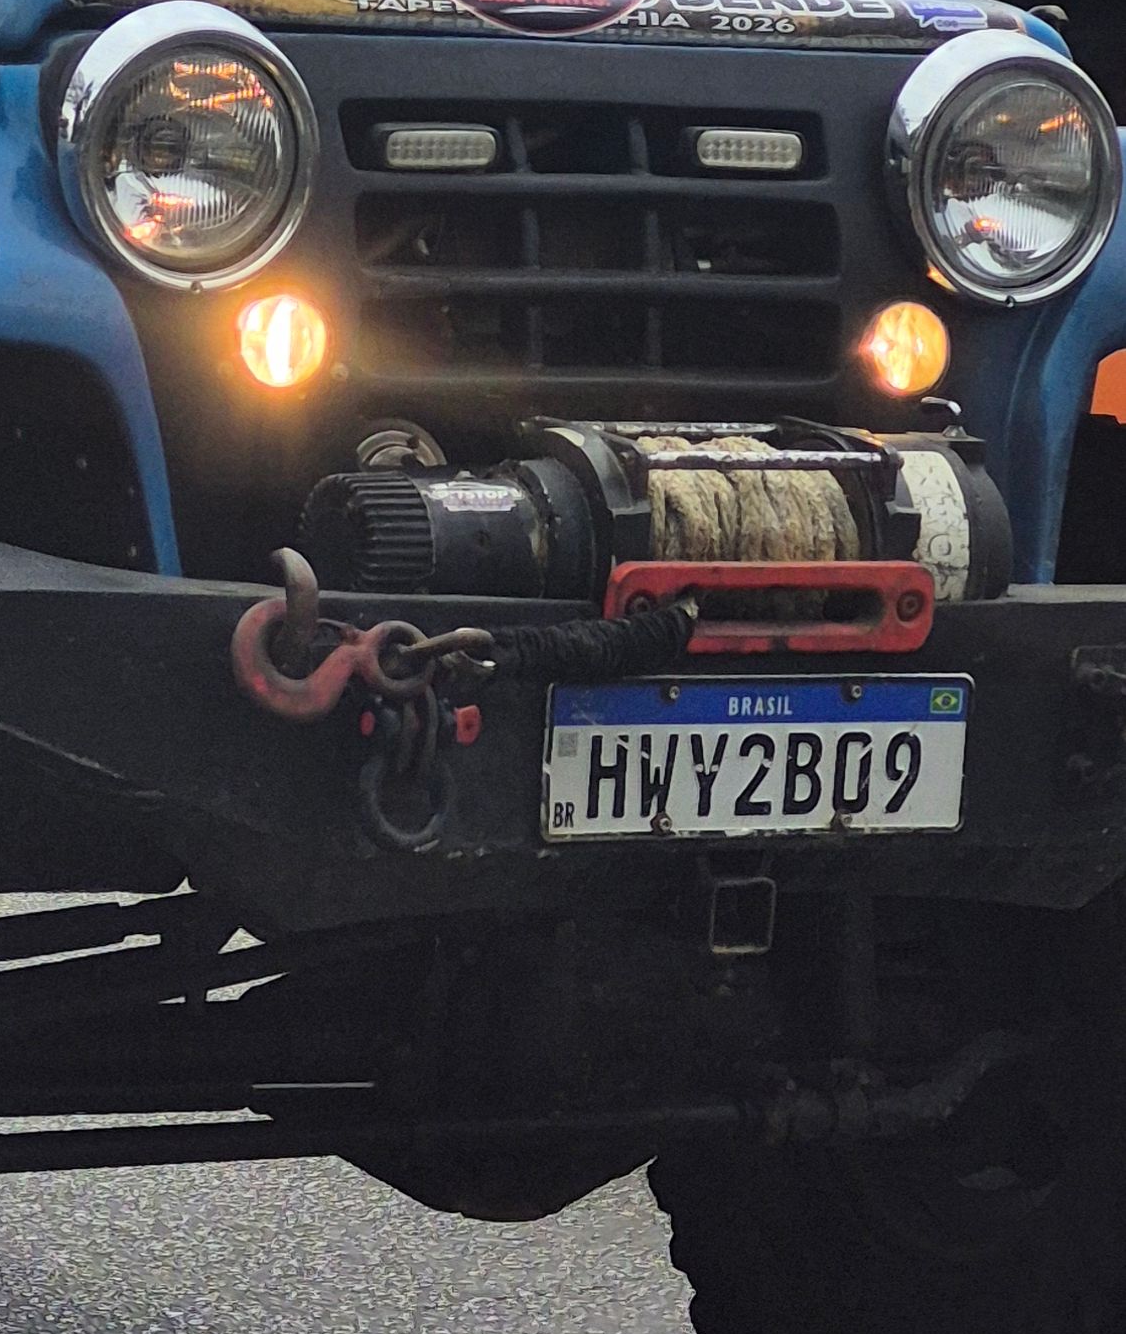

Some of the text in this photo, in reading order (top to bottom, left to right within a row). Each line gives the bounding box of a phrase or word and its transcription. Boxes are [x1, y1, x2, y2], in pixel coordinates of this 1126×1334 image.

[613, 10, 691, 29] HIA
[711, 15, 796, 34] 2026
[727, 696, 793, 717] BRASIL
[586, 731, 923, 819] HWY2B09
[552, 802, 575, 829] BR
